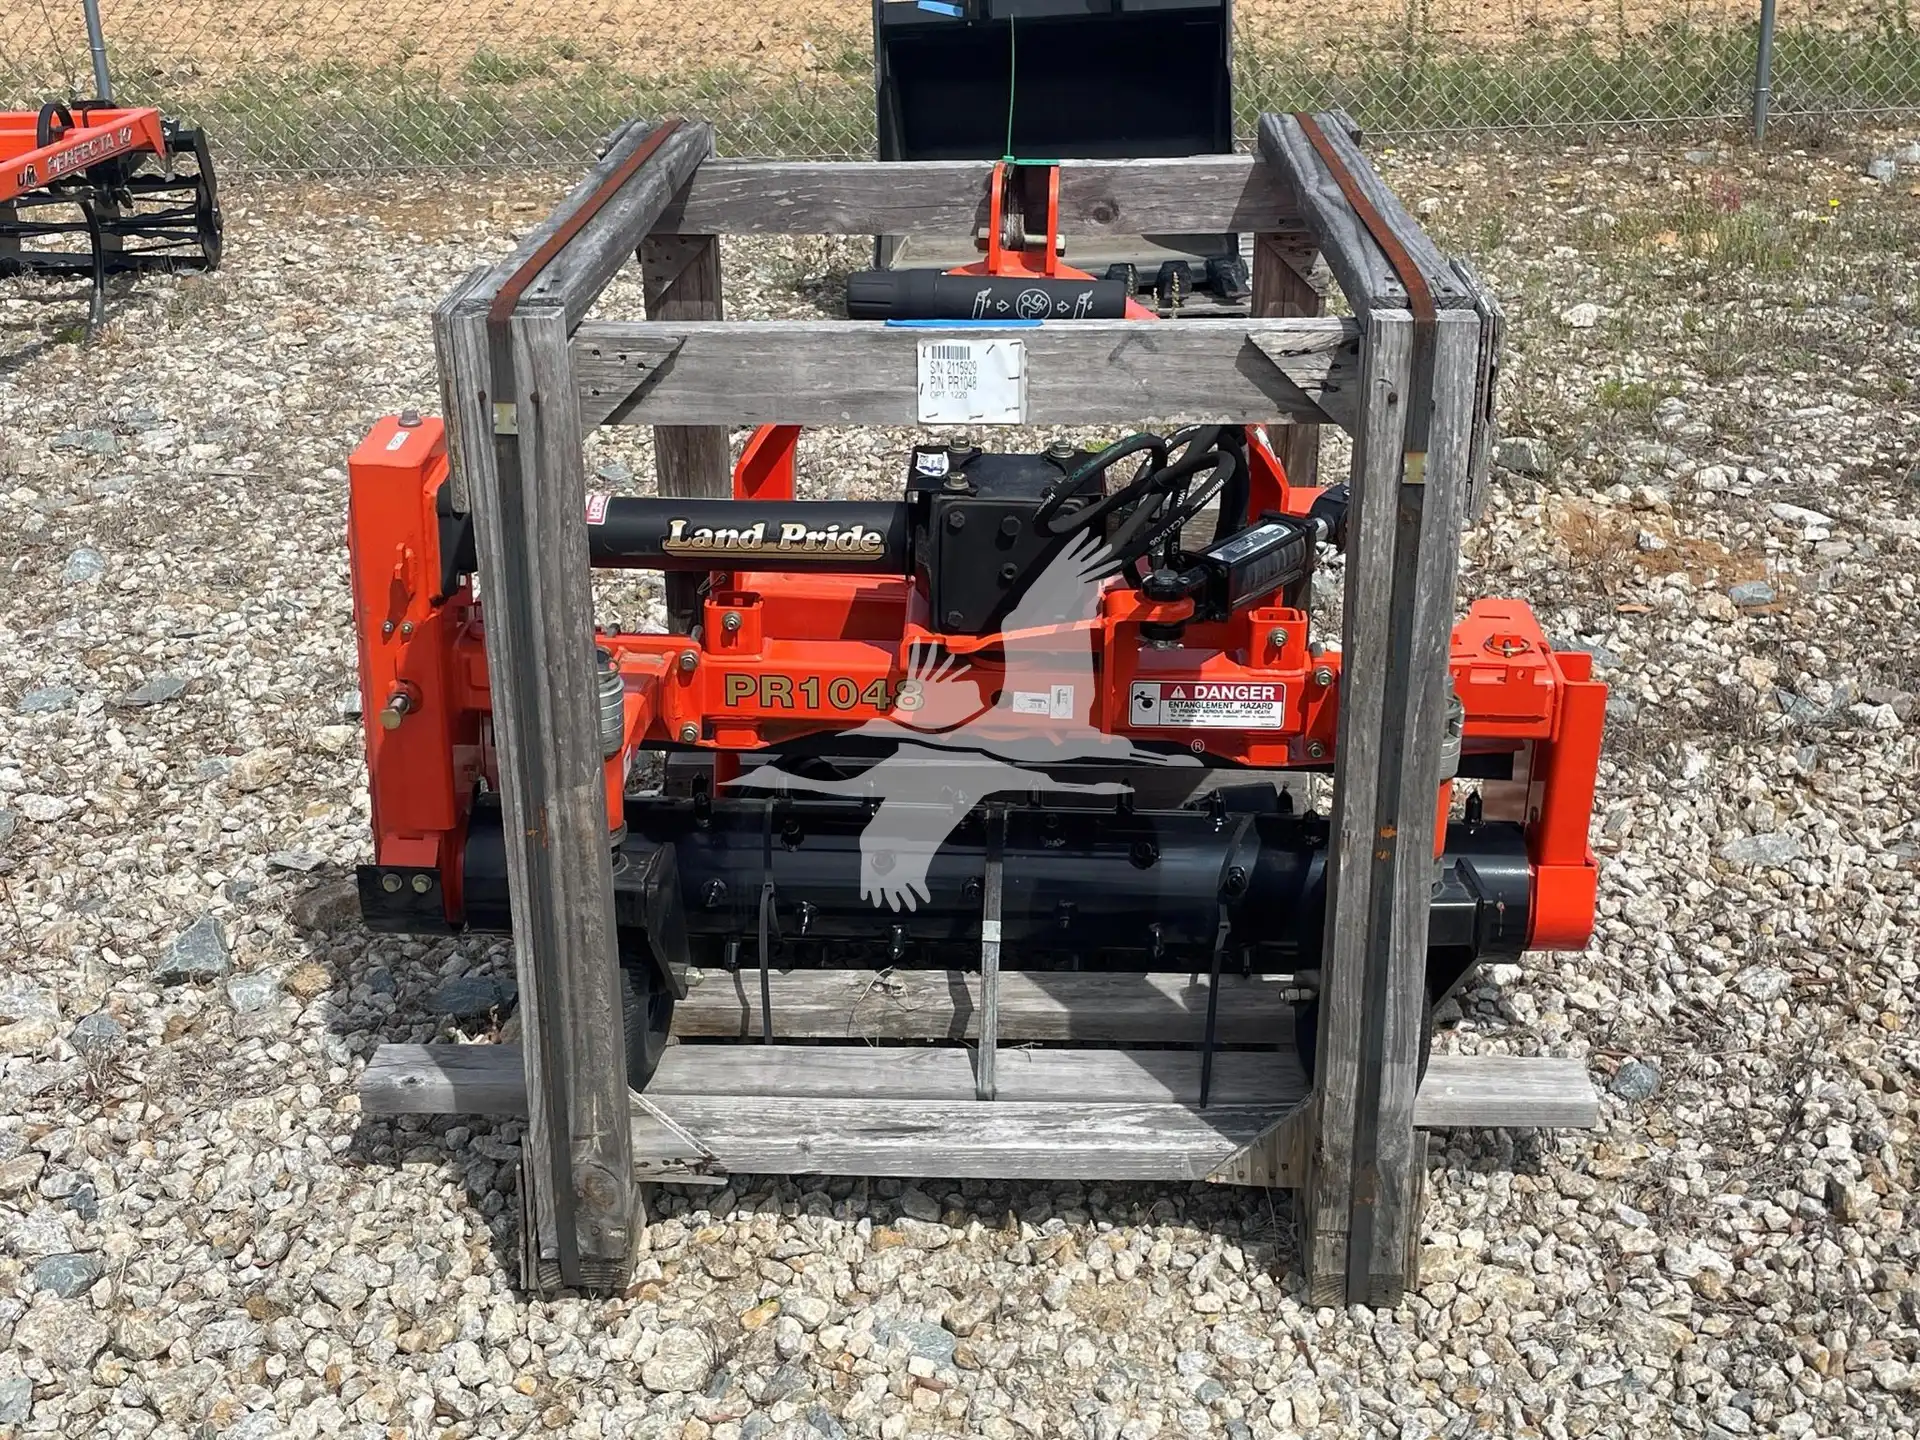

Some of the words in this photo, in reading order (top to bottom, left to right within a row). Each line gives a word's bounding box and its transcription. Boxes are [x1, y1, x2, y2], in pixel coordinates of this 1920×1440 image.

[47, 133, 115, 174] PERFECTA
[947, 360, 977, 375] 2115929
[948, 375, 977, 391] PR1048
[667, 519, 766, 550] Land
[776, 523, 883, 552] Pride
[725, 673, 925, 711] PR1048
[1194, 685, 1275, 700] DANGER
[1168, 701, 1234, 710] ENTANGLEMENT
[1239, 702, 1274, 711] HAZARD
